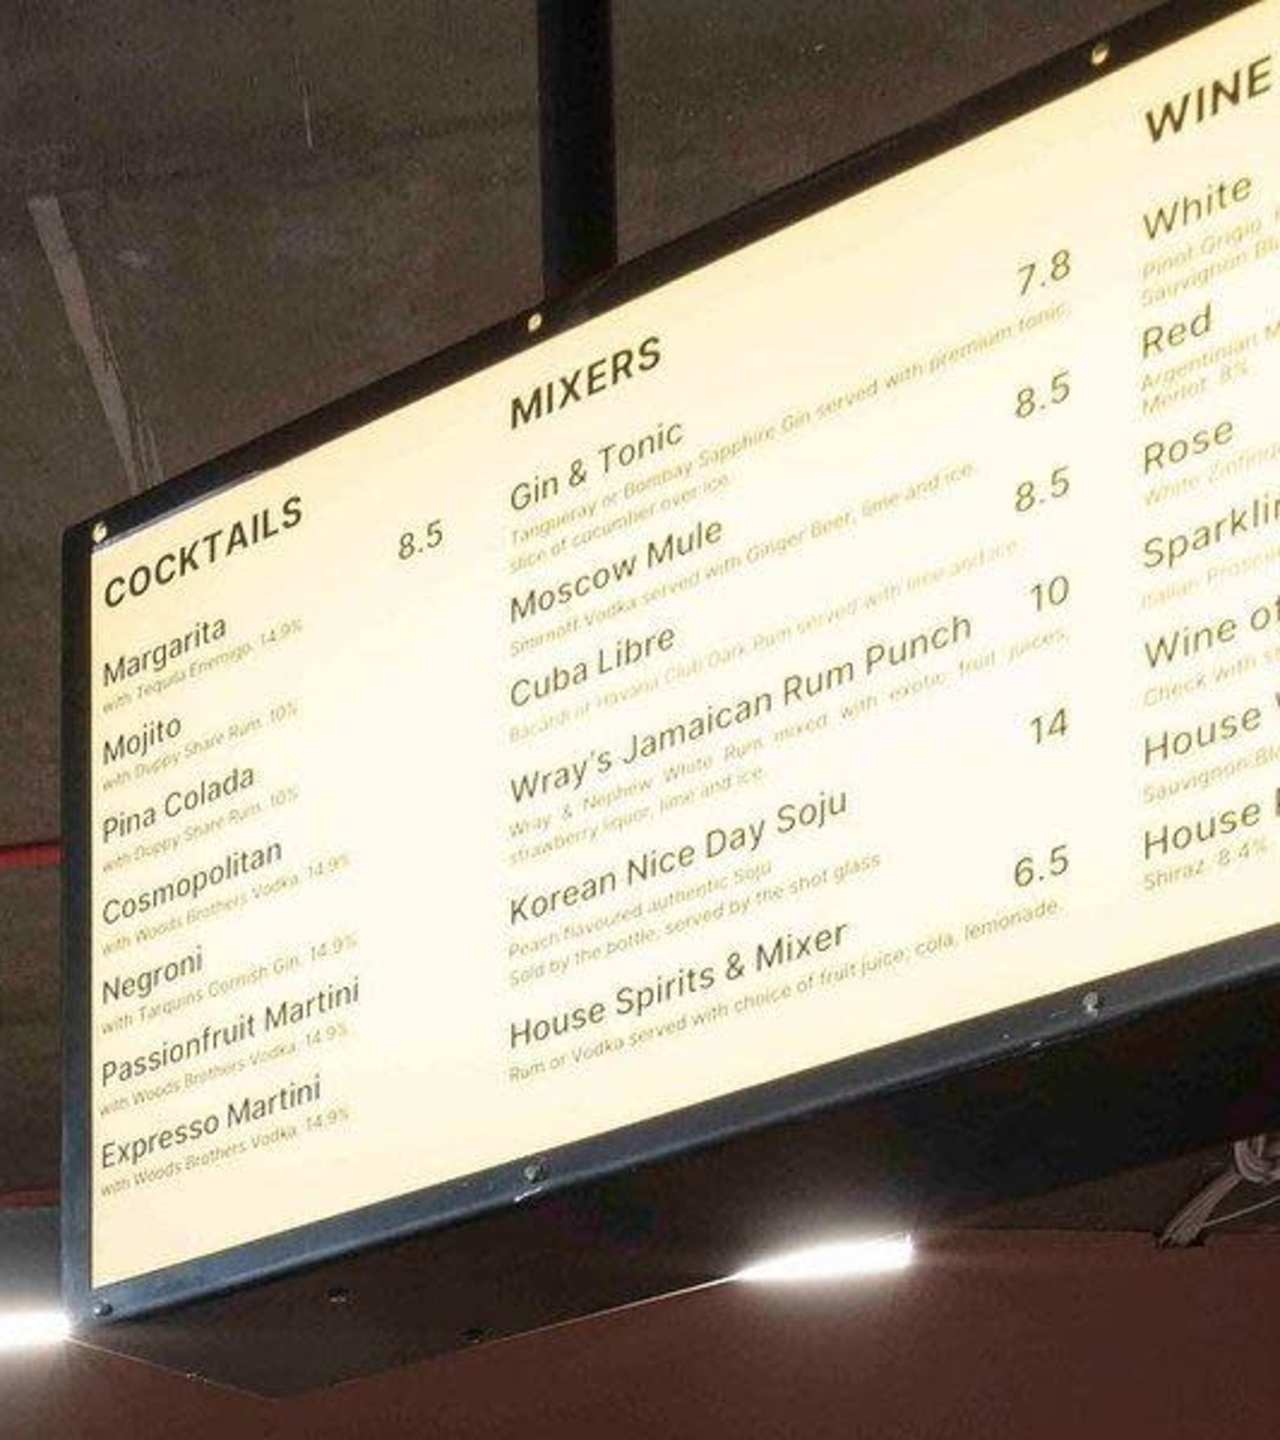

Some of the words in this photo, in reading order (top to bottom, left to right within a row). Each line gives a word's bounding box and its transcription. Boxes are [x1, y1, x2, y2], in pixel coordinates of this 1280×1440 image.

[1145, 54, 1272, 143] WINE
[1142, 177, 1252, 241] White
[1018, 249, 1071, 296] 7.8
[1142, 302, 1212, 359] Red
[511, 335, 661, 431] MIXERS
[1015, 371, 1070, 419] 8.5
[510, 475, 559, 511] Gin
[568, 458, 587, 488] &
[598, 423, 683, 474] Tonic
[1144, 421, 1233, 475] Rose
[1014, 466, 1070, 512] 8.5
[104, 495, 303, 609] COCKTAILS
[398, 519, 443, 561] 8.5
[511, 555, 637, 624] Moscow
[647, 521, 722, 569] Mule
[1031, 575, 1070, 612] 10
[103, 618, 226, 688] Margarita
[510, 662, 588, 707] Cuba
[598, 628, 675, 675] Libre
[1144, 618, 1238, 669] Wine
[103, 717, 182, 766] Mojito
[510, 751, 613, 804] Wray's
[622, 692, 772, 765] Jamaican
[783, 661, 854, 706] Rum
[865, 615, 971, 675] Punch
[1031, 707, 1068, 745] 14
[1145, 707, 1261, 767] House
[102, 807, 157, 844] Pina
[164, 768, 254, 818] Colada
[1144, 803, 1261, 860] House
[102, 842, 282, 925] Cosmopolitan
[511, 871, 616, 925] Korean
[627, 845, 696, 886] Nice
[706, 819, 765, 859] Day
[777, 791, 847, 834] Soju
[1014, 844, 1069, 888] 6.5
[102, 945, 202, 1005] Negroni
[511, 1002, 606, 1049] House
[616, 967, 715, 1017] Spirits
[725, 951, 745, 981] &
[756, 923, 848, 972] Mixer
[102, 1014, 255, 1088] Passionfruit
[265, 976, 359, 1032] Martini
[101, 1114, 219, 1170] Expresso
[227, 1073, 320, 1129] Martini
